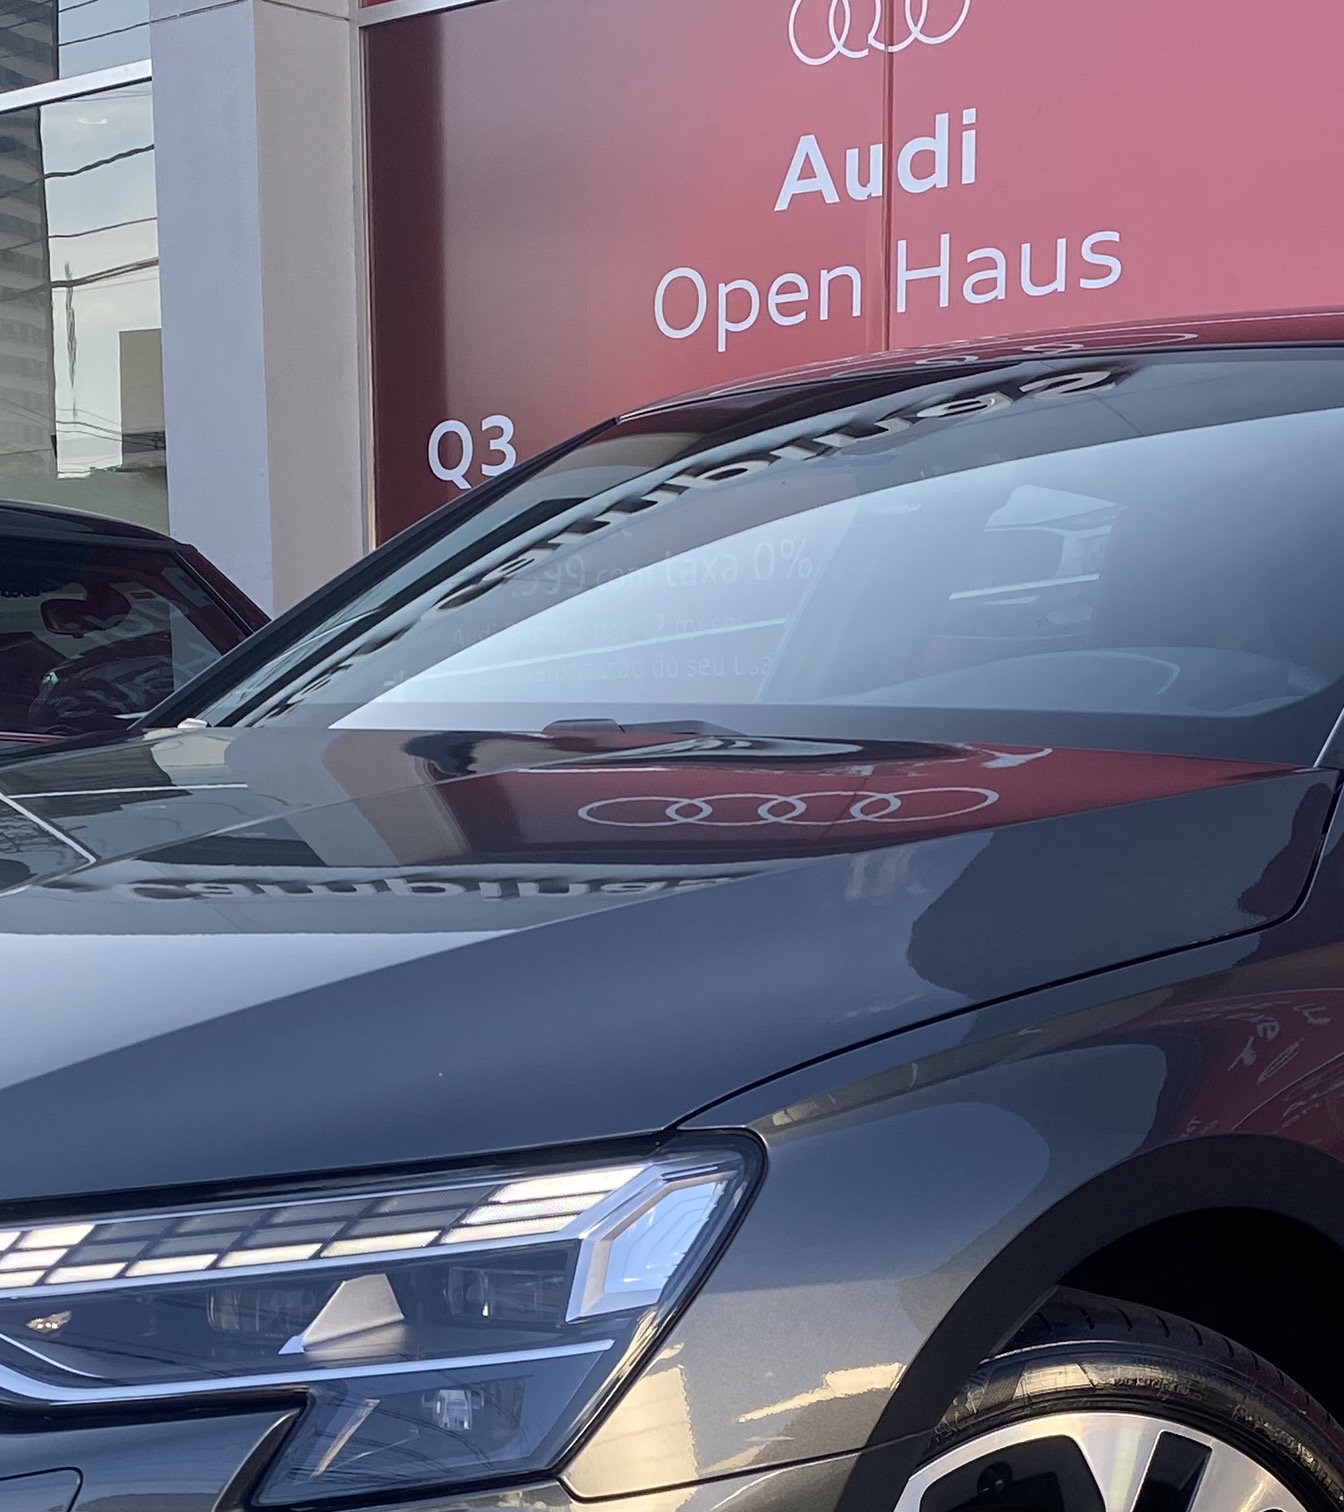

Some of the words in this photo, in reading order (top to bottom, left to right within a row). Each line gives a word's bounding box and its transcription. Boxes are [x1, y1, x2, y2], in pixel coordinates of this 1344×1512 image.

[772, 107, 980, 213] Audi
[652, 261, 862, 354] Open
[895, 229, 1124, 314] Haus
[427, 414, 518, 490] Q3
